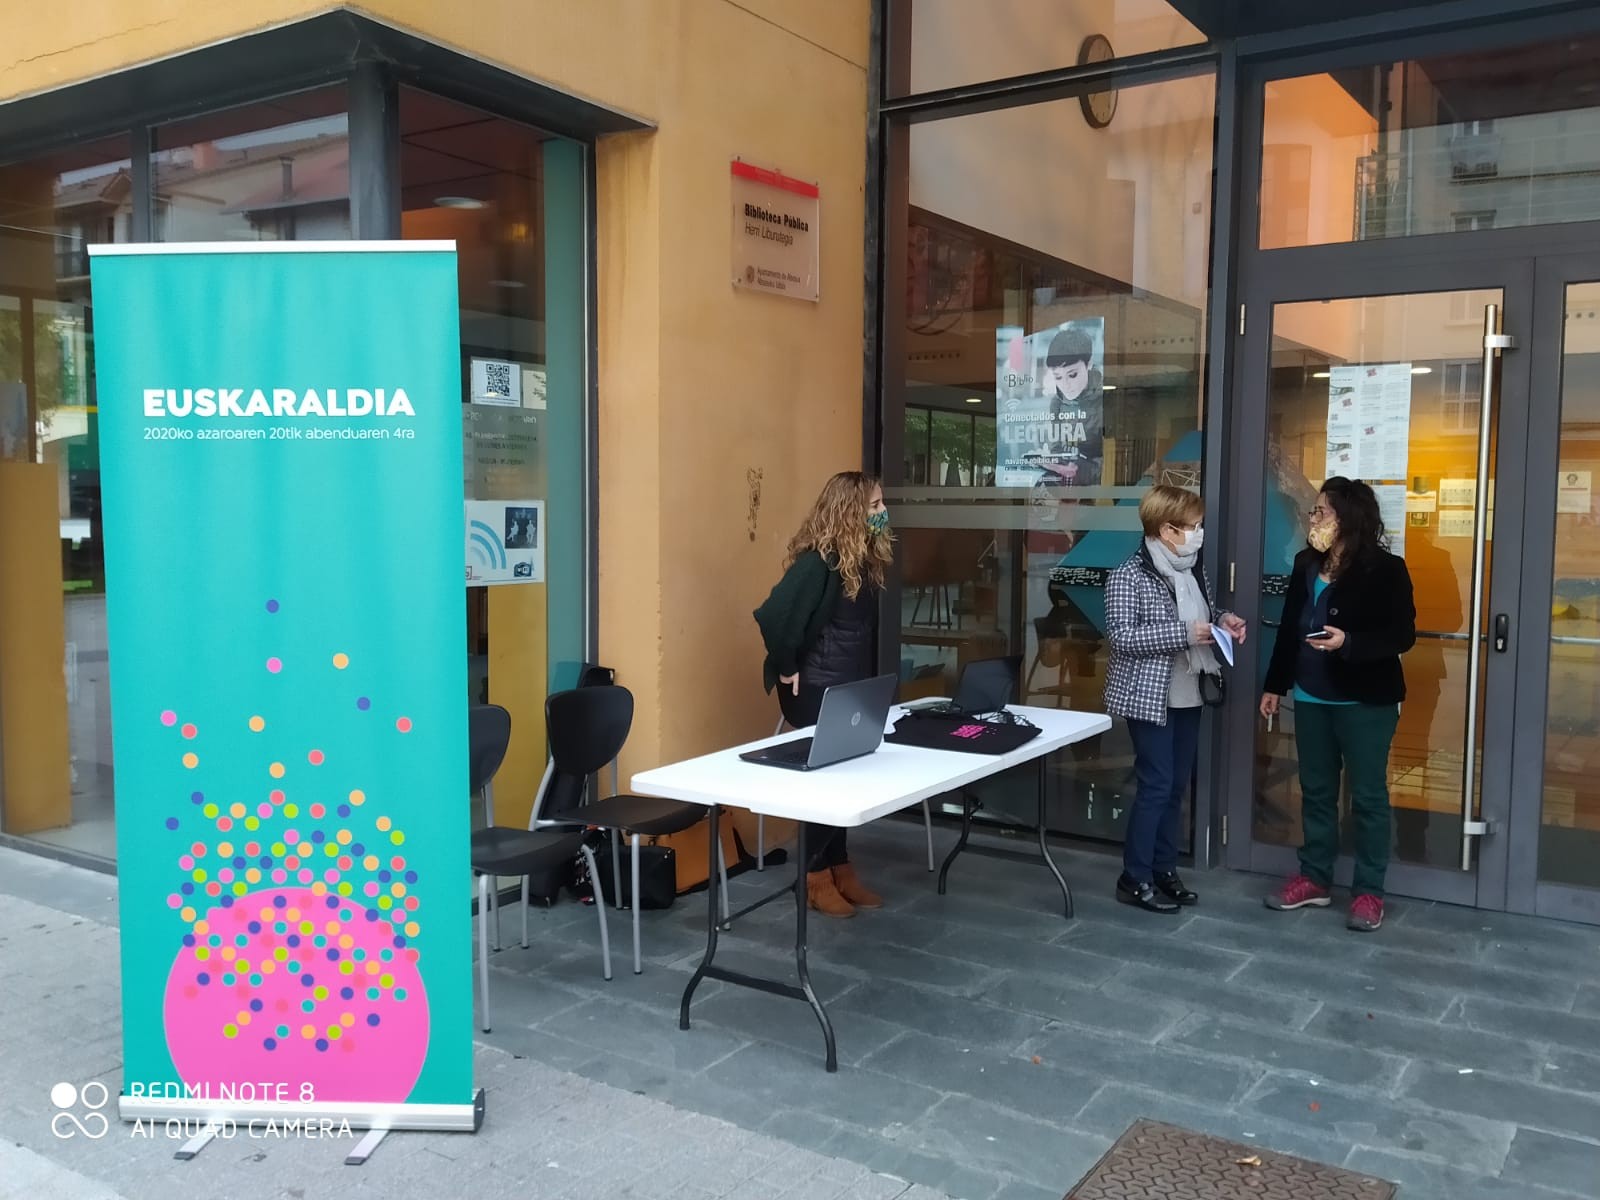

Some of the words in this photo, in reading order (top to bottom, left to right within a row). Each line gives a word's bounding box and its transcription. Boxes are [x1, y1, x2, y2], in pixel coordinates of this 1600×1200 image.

[745, 203, 781, 224] Biblioteca
[784, 214, 808, 232] Pública
[143, 388, 416, 418] EUSKARALDIA
[1004, 411, 1055, 422] Conectados
[1058, 410, 1076, 421] con
[1077, 409, 1087, 420] la
[143, 427, 194, 440] 2020ko
[196, 428, 266, 440] azaroaren
[268, 427, 302, 440] 20tik
[304, 427, 390, 440] abenduaren
[392, 428, 416, 440] 4ra
[1005, 422, 1086, 443] LECTURA
